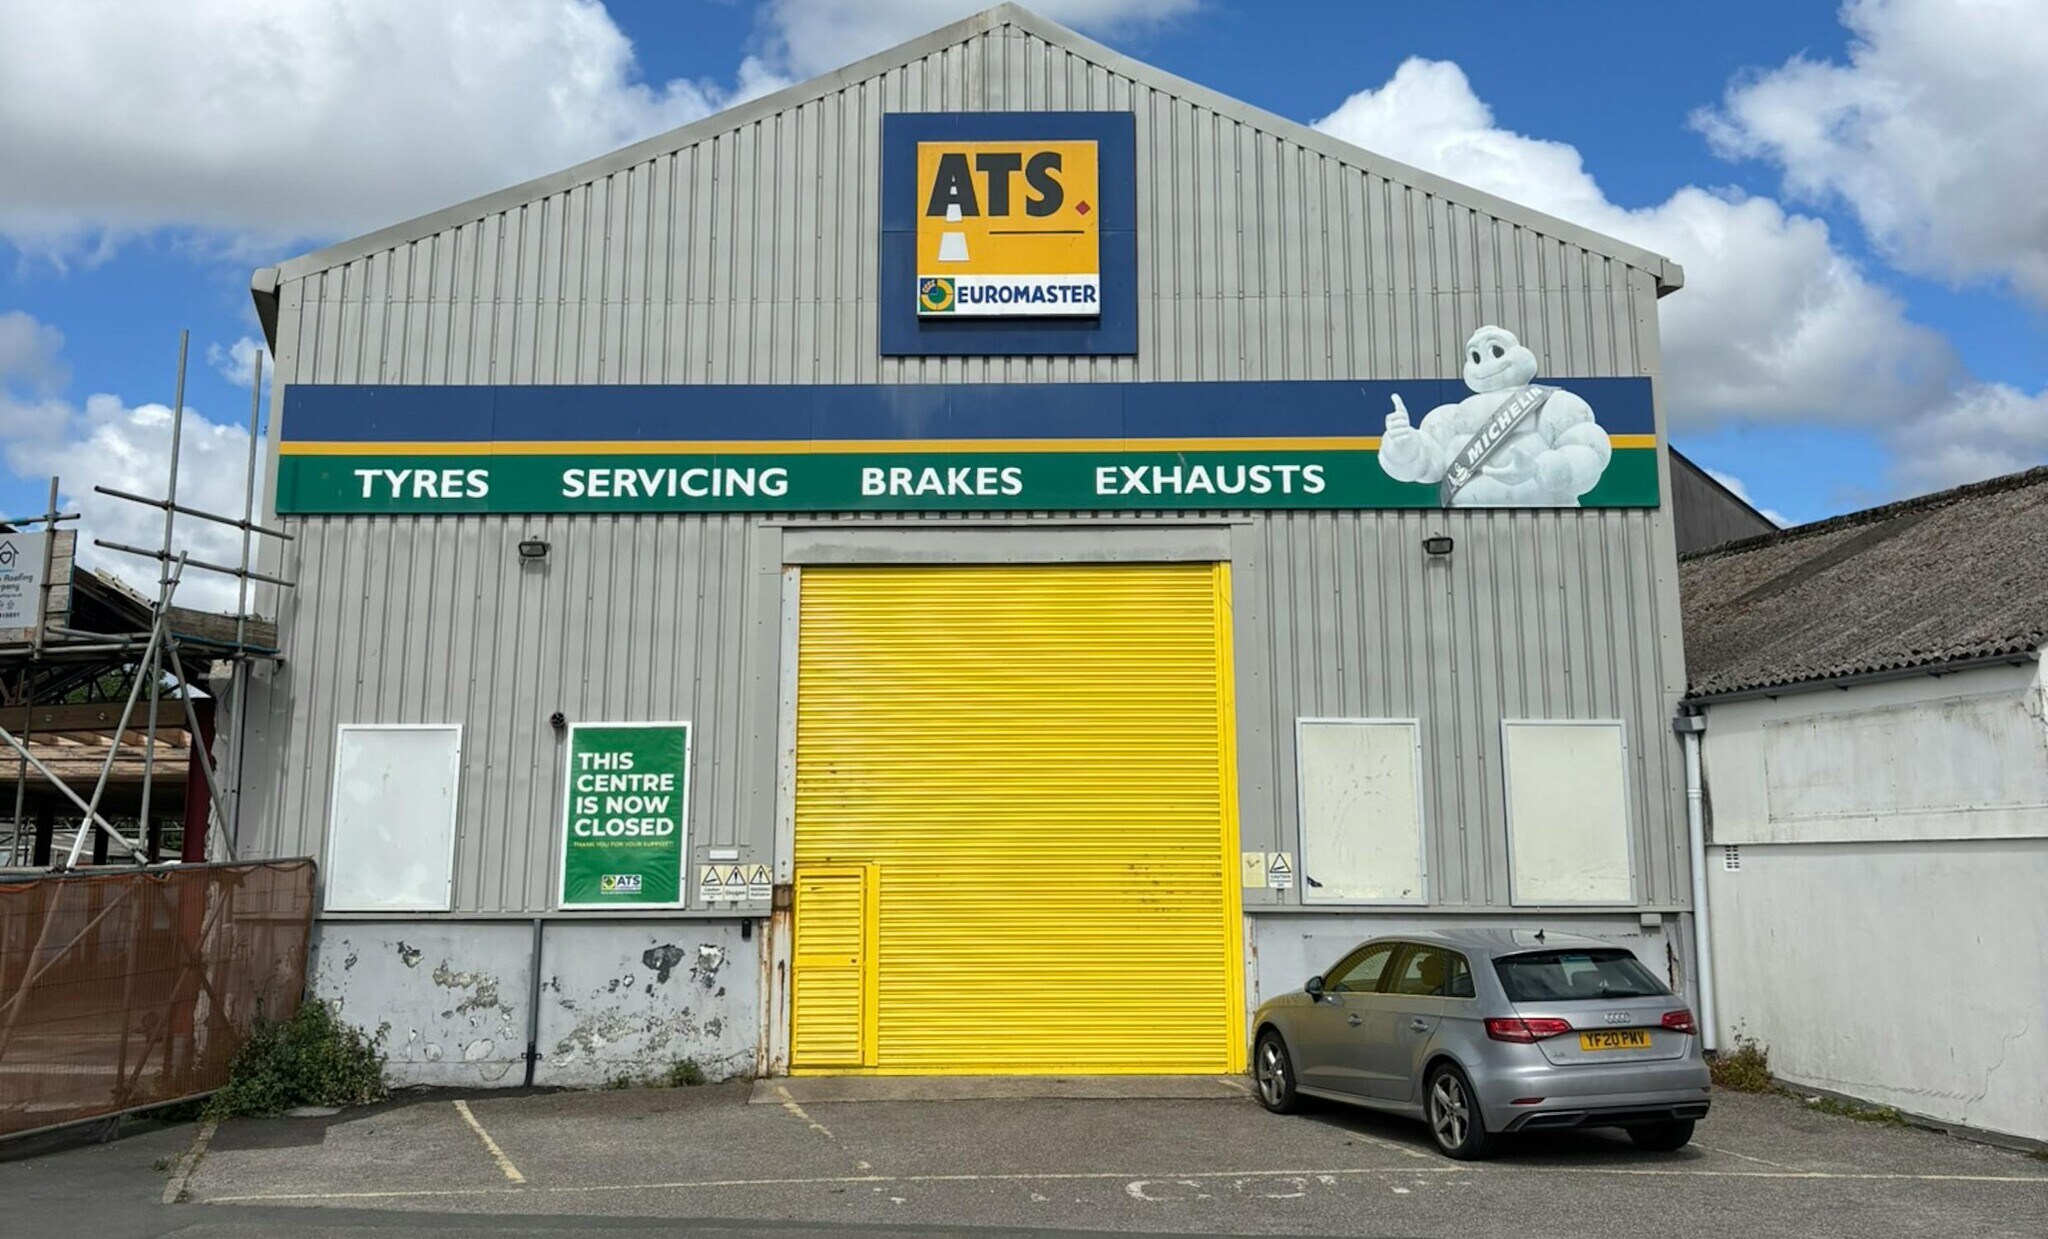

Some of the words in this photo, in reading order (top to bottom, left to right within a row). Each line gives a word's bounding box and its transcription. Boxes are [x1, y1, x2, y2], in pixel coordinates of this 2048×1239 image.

[926, 151, 1064, 217] ATS
[957, 285, 1097, 304] EUROMASTER
[1467, 387, 1543, 464] MICHELIN
[354, 468, 489, 498] TYRES
[562, 467, 788, 498] SERVICING
[860, 466, 1023, 496] BRAKES
[1095, 464, 1326, 495] EXHAUSTS
[578, 752, 634, 770] THIS
[577, 774, 674, 792] CENTRE
[576, 796, 598, 814] IS
[606, 796, 669, 814] NOW
[574, 818, 674, 836] CLOSED
[617, 875, 640, 885] ATS
[1586, 1032, 1619, 1047] YF20
